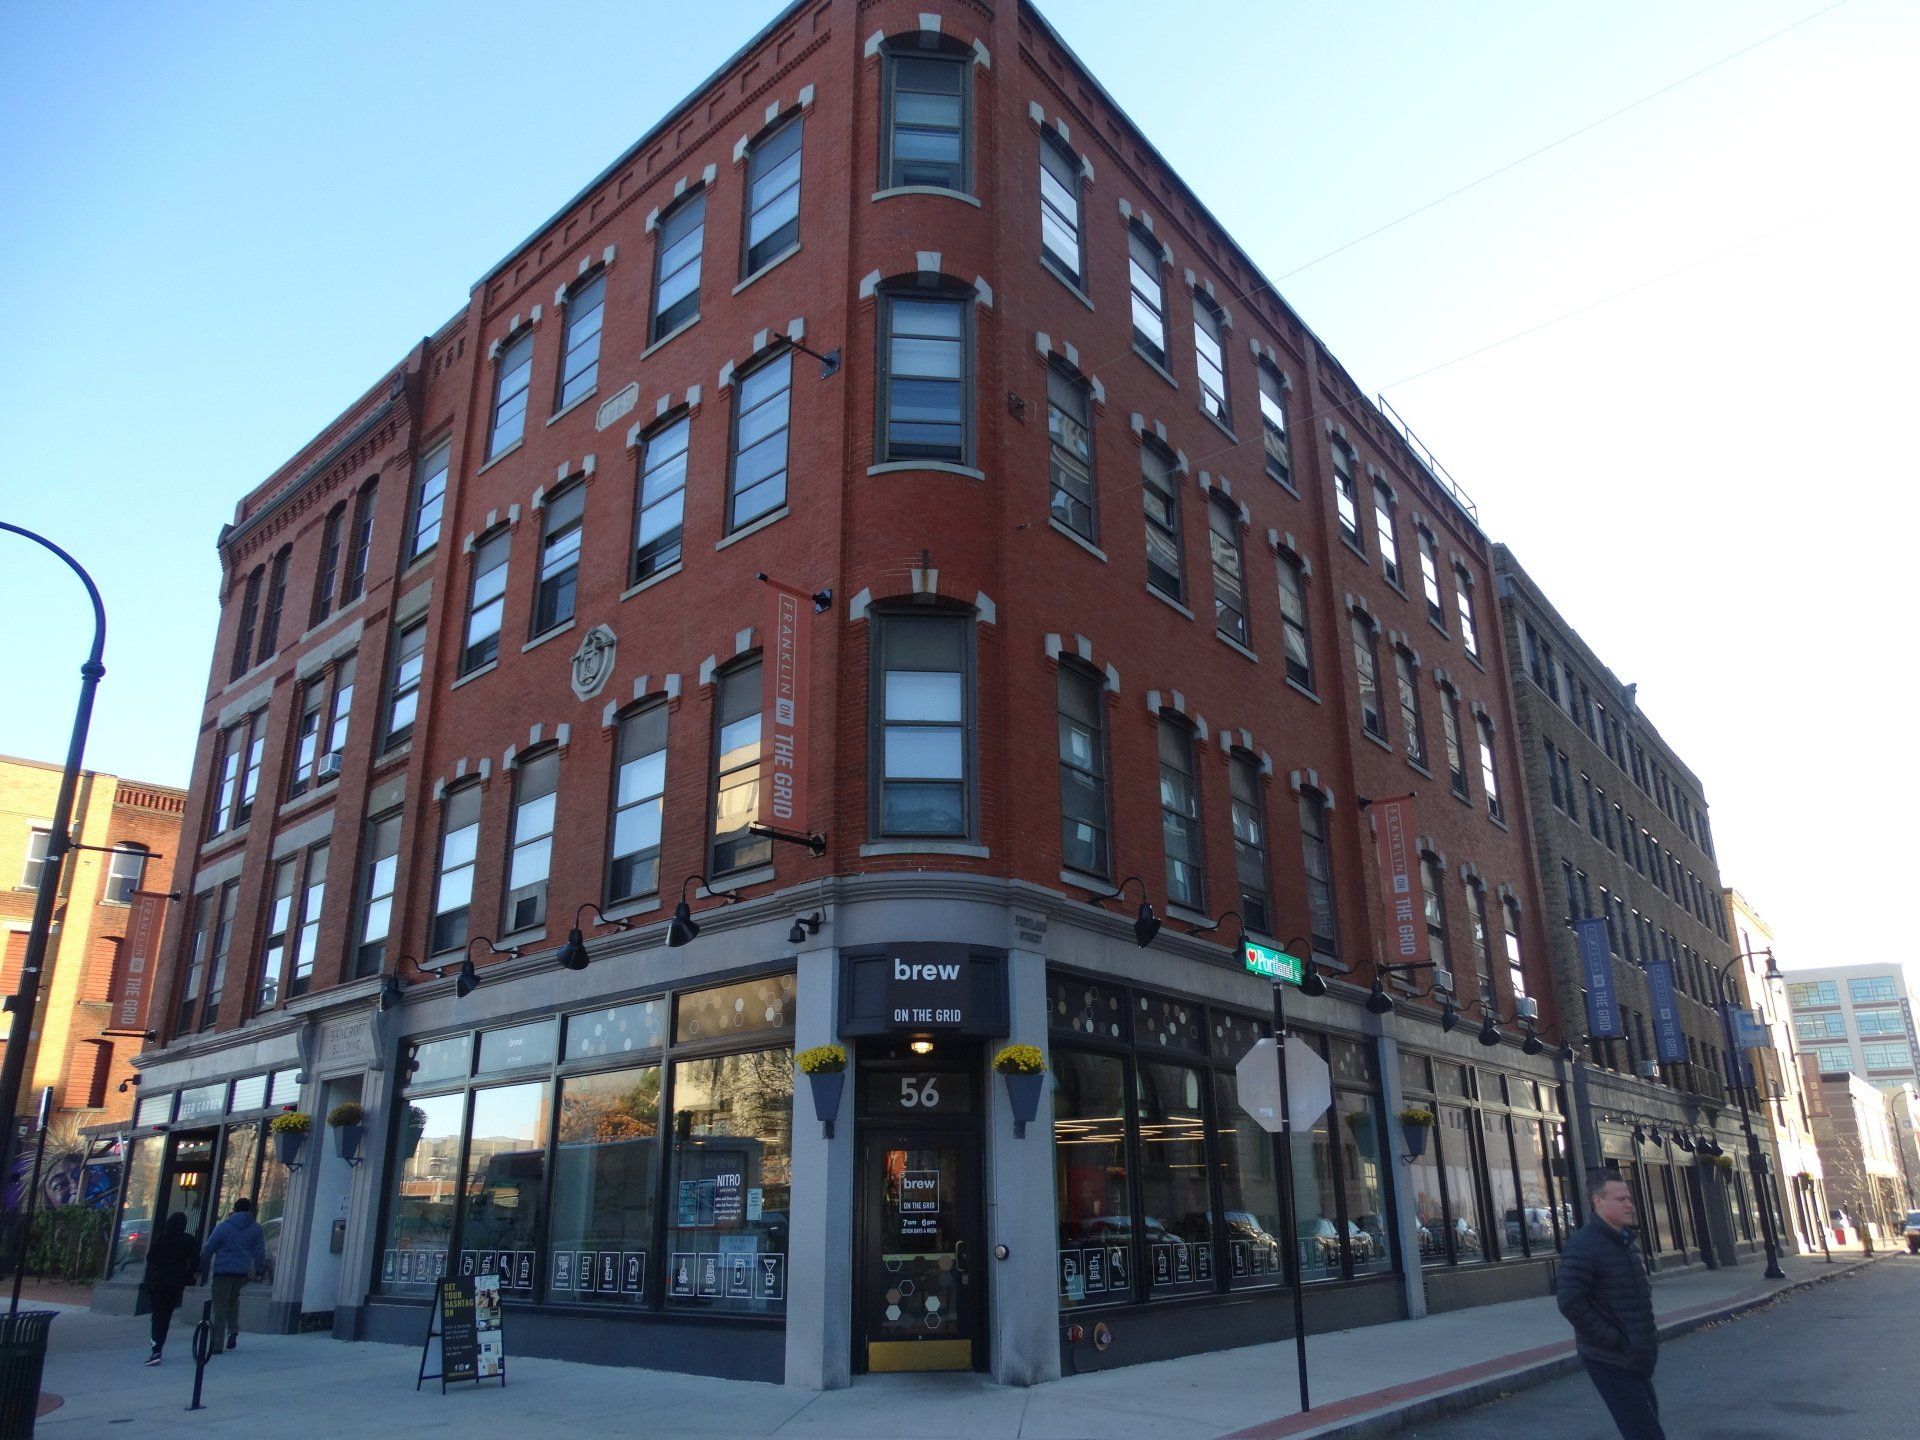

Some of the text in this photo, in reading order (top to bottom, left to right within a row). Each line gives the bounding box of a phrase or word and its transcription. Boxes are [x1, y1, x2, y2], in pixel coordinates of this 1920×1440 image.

[773, 602, 793, 819] FRANKLIN ON THE GRID
[1389, 809, 1416, 955] FRANKLIN ON THE GRID
[138, 902, 153, 957] FRANKLIN
[894, 958, 960, 981] brew
[1257, 950, 1294, 980] Portland
[126, 977, 142, 996] THE
[1595, 990, 1608, 1008] THE
[120, 1000, 139, 1025] GRID
[894, 1009, 961, 1022] ON THE GRID
[1598, 1009, 1612, 1031] GRID
[330, 1023, 366, 1043] BANCROFT
[1662, 1022, 1675, 1039] THE
[332, 1040, 361, 1055] BUILDING
[1665, 1038, 1678, 1057] GRID
[900, 1077, 940, 1108] 56
[199, 1098, 223, 1112] GARDEN
[717, 1173, 741, 1187] NITRO
[903, 1177, 936, 1189] brew
[903, 1201, 935, 1210] ON THE GRID
[902, 1218, 937, 1227] 7am 6pm
[444, 1283, 456, 1291] GET
[444, 1291, 462, 1300] YOUR
[445, 1299, 474, 1308] HASHTAG
[445, 1309, 454, 1317] ON
